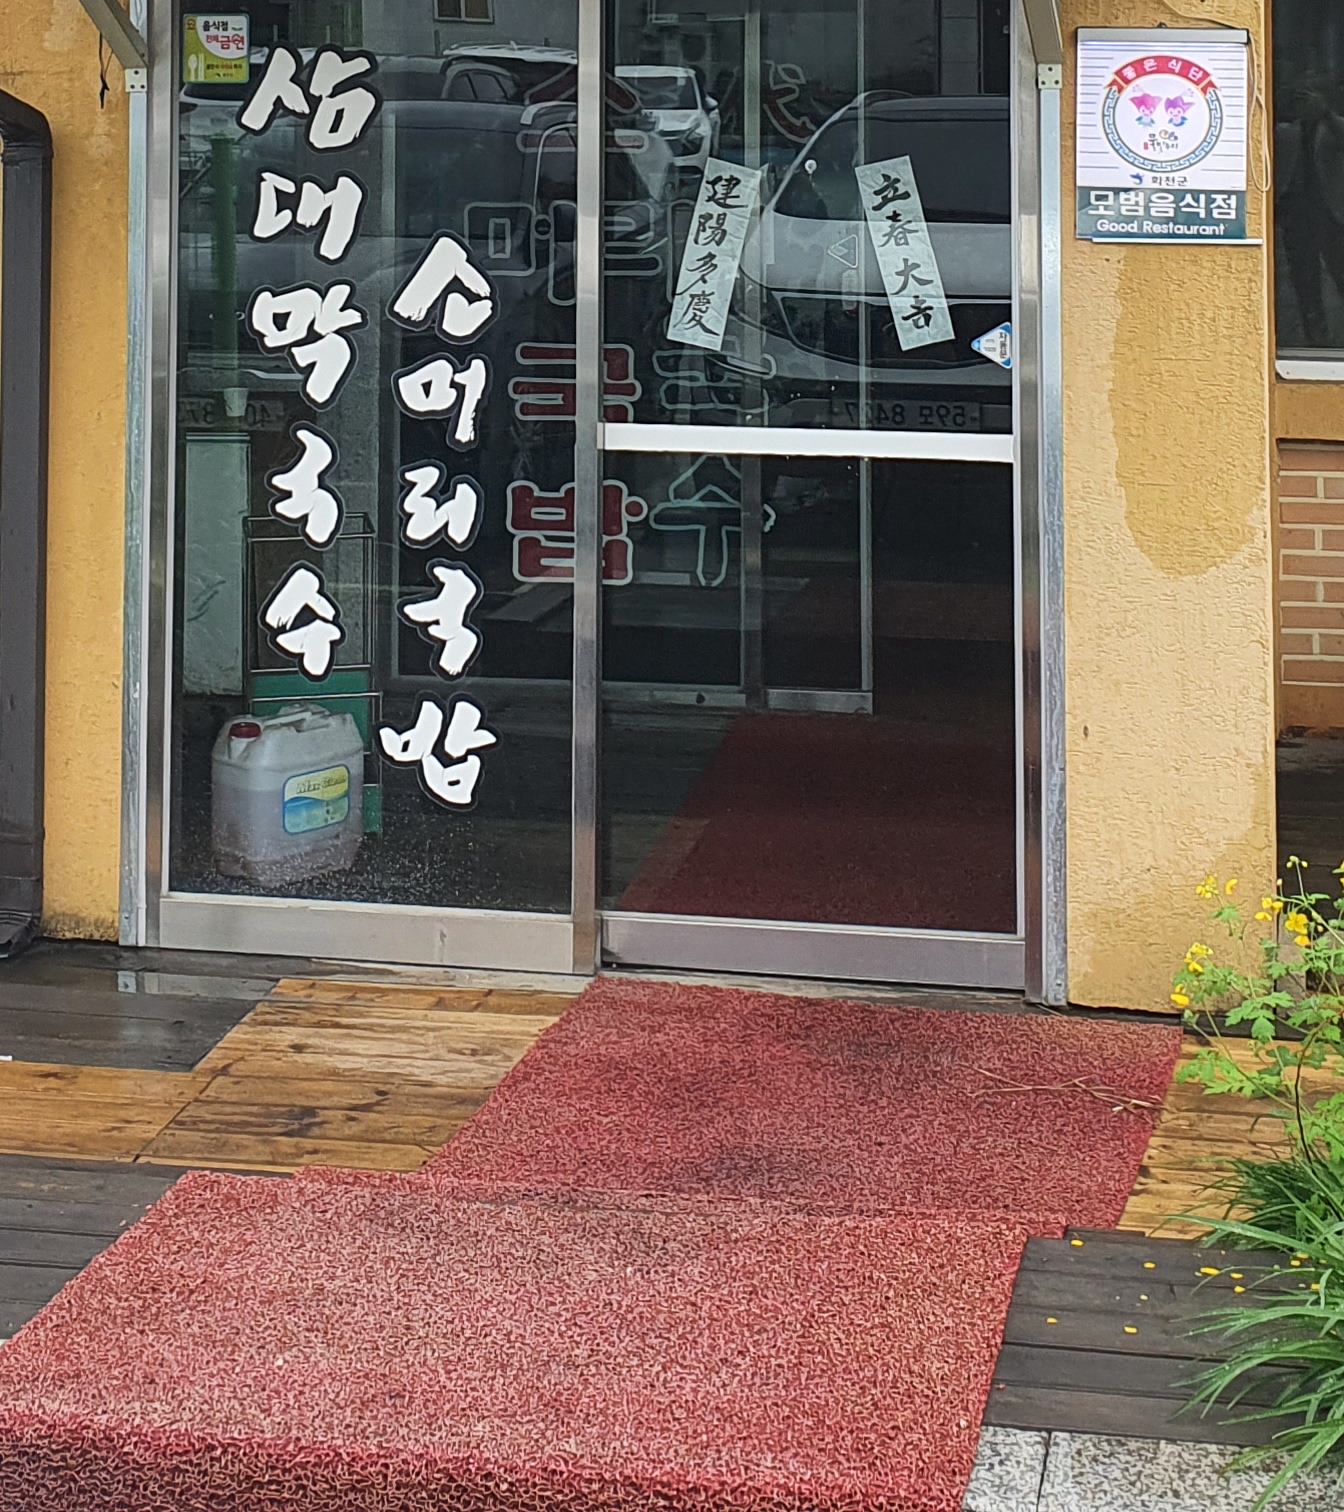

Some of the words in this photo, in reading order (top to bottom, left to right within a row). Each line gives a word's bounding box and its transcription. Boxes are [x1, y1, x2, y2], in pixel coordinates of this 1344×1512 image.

[1087, 190, 1237, 220] 모범음식점
[1096, 219, 1138, 233] Good
[1143, 220, 1225, 236] Restaurant
